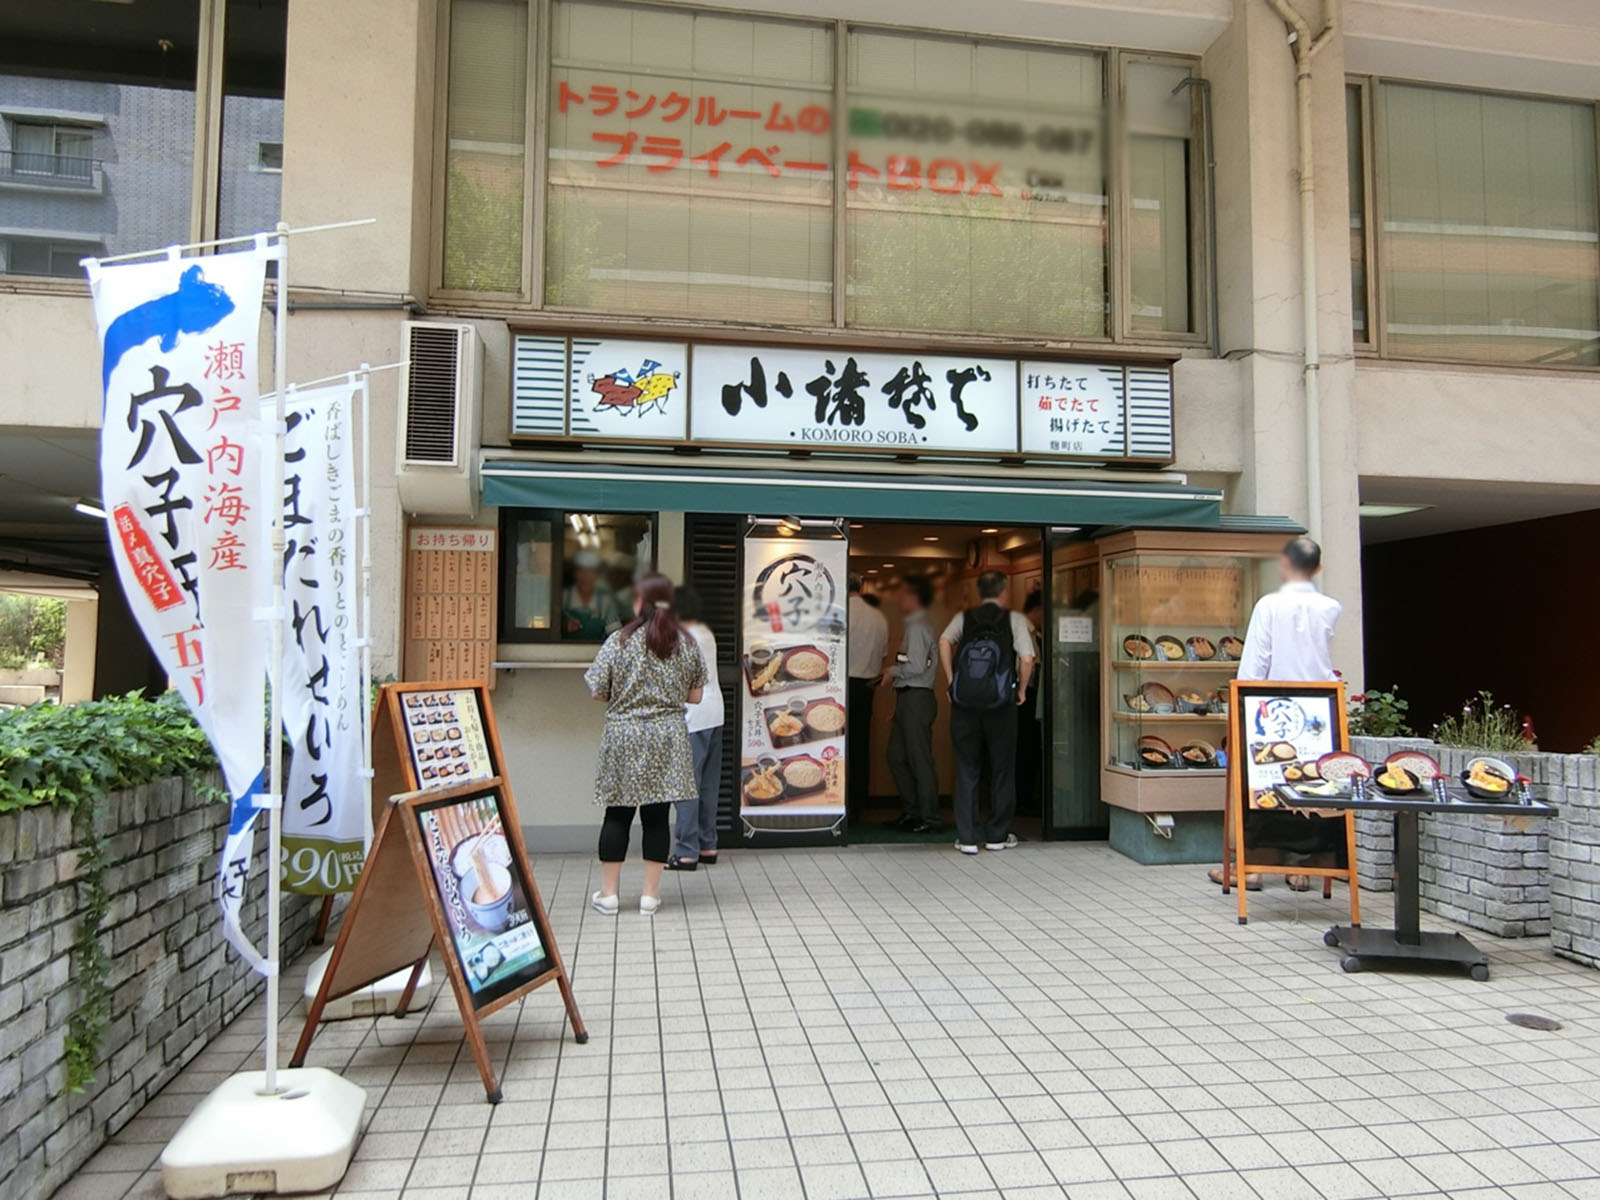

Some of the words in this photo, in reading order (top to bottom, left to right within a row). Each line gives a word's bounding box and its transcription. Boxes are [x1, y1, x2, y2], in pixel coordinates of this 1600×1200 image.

[556, 81, 833, 136] トランクルームの
[1027, 373, 1088, 391] 打ちたて
[1038, 395, 1099, 413] 茹でたて
[1050, 417, 1111, 434] 揚げたて
[801, 427, 873, 442] KOMORO
[876, 431, 919, 445] SOBA
[203, 340, 251, 571] 瀬戸内海産
[416, 533, 490, 547] お持ち帰り
[779, 562, 813, 628] 穴子
[1271, 701, 1293, 739] 穴子
